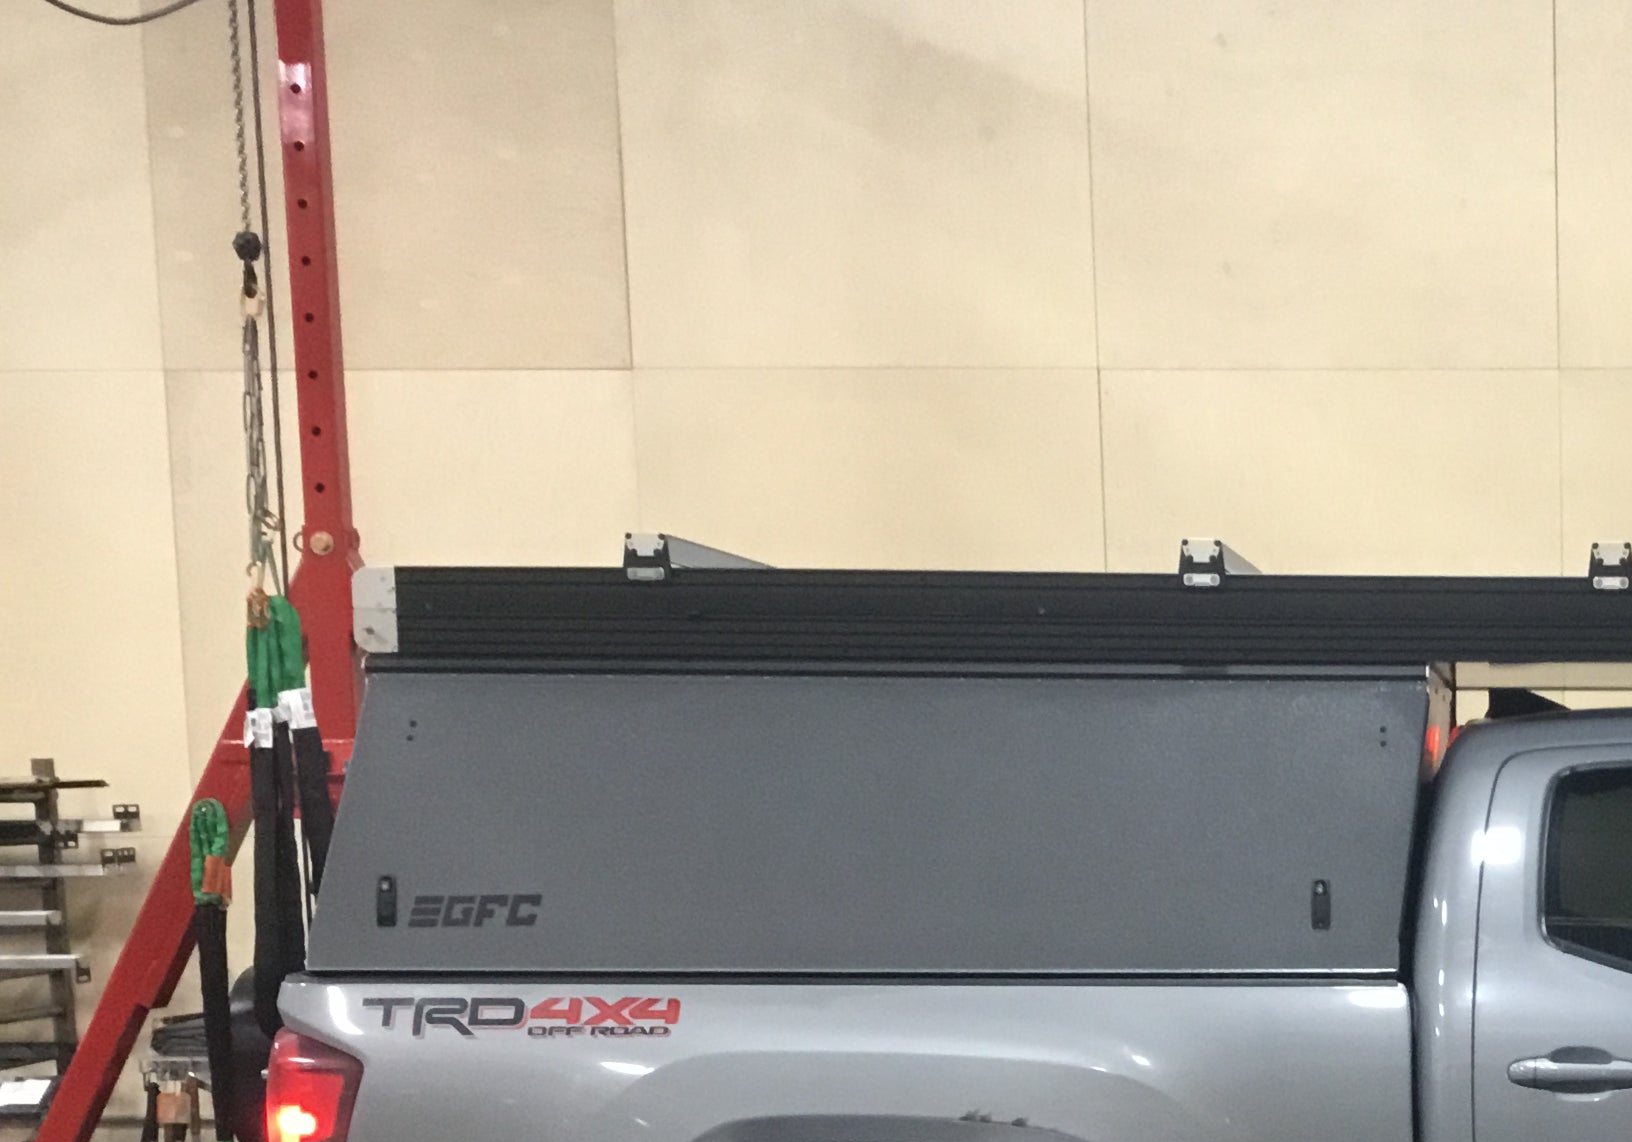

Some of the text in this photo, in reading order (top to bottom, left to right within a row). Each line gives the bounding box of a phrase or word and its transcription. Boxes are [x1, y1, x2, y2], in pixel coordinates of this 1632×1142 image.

[362, 996, 681, 1037] TRD 4X4
[527, 1025, 671, 1038] OFF ROAD
